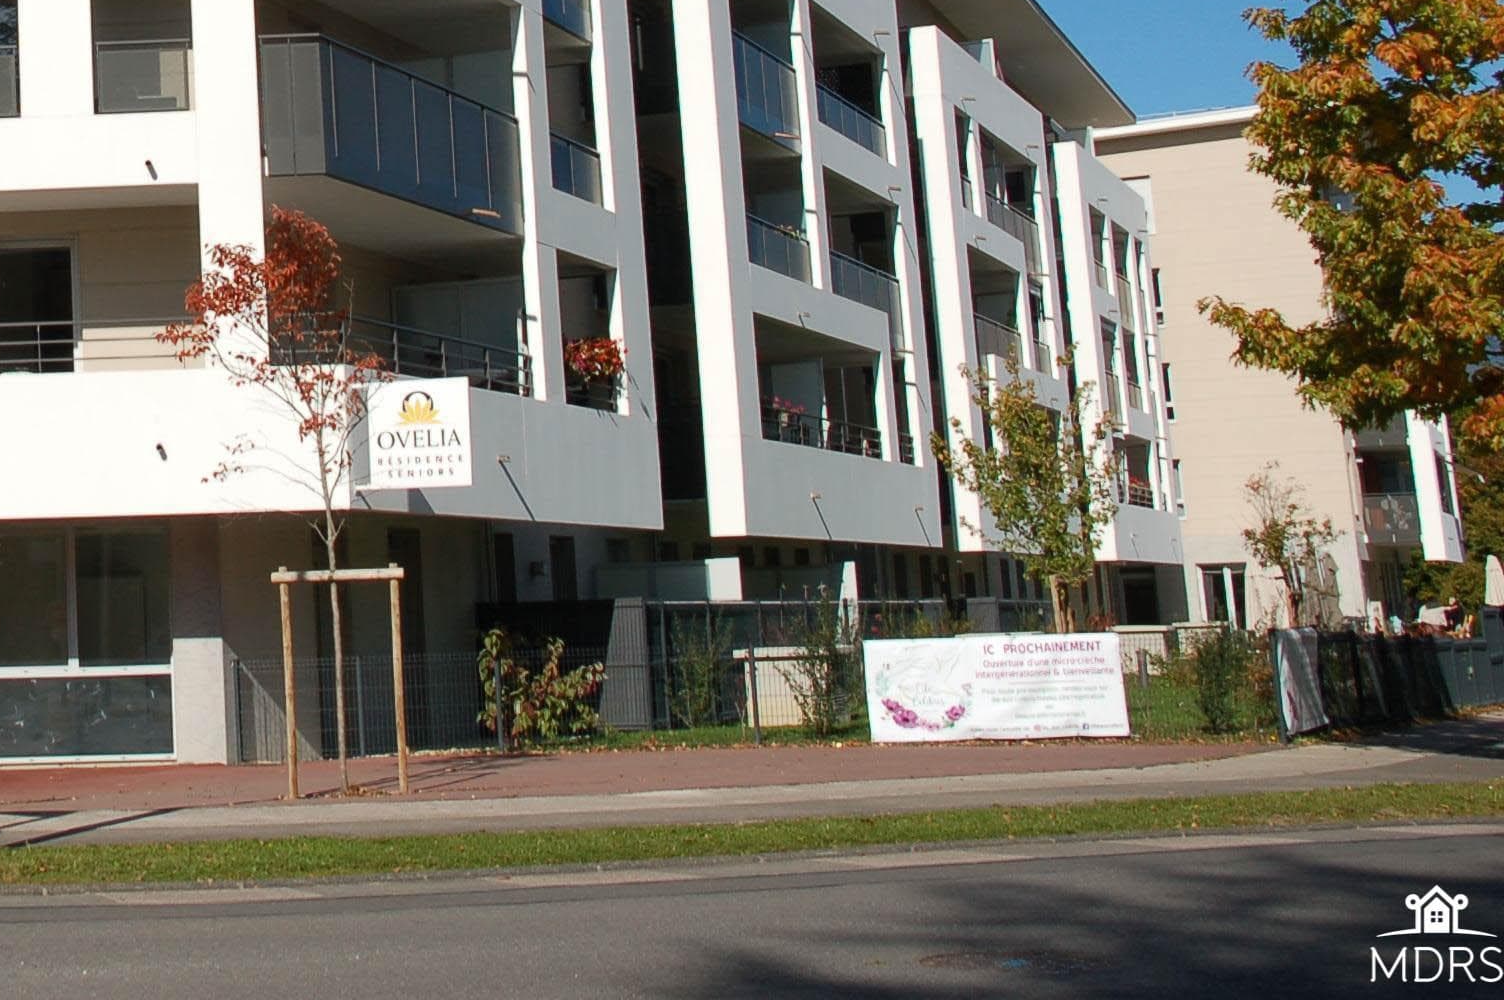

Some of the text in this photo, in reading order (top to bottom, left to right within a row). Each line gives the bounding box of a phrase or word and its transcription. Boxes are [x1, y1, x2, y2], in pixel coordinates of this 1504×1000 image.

[377, 428, 461, 450] OVELIA
[388, 468, 454, 478] SENIORS
[1003, 640, 1102, 654] PROCHAINEMENT
[983, 659, 1024, 668] Ouverture
